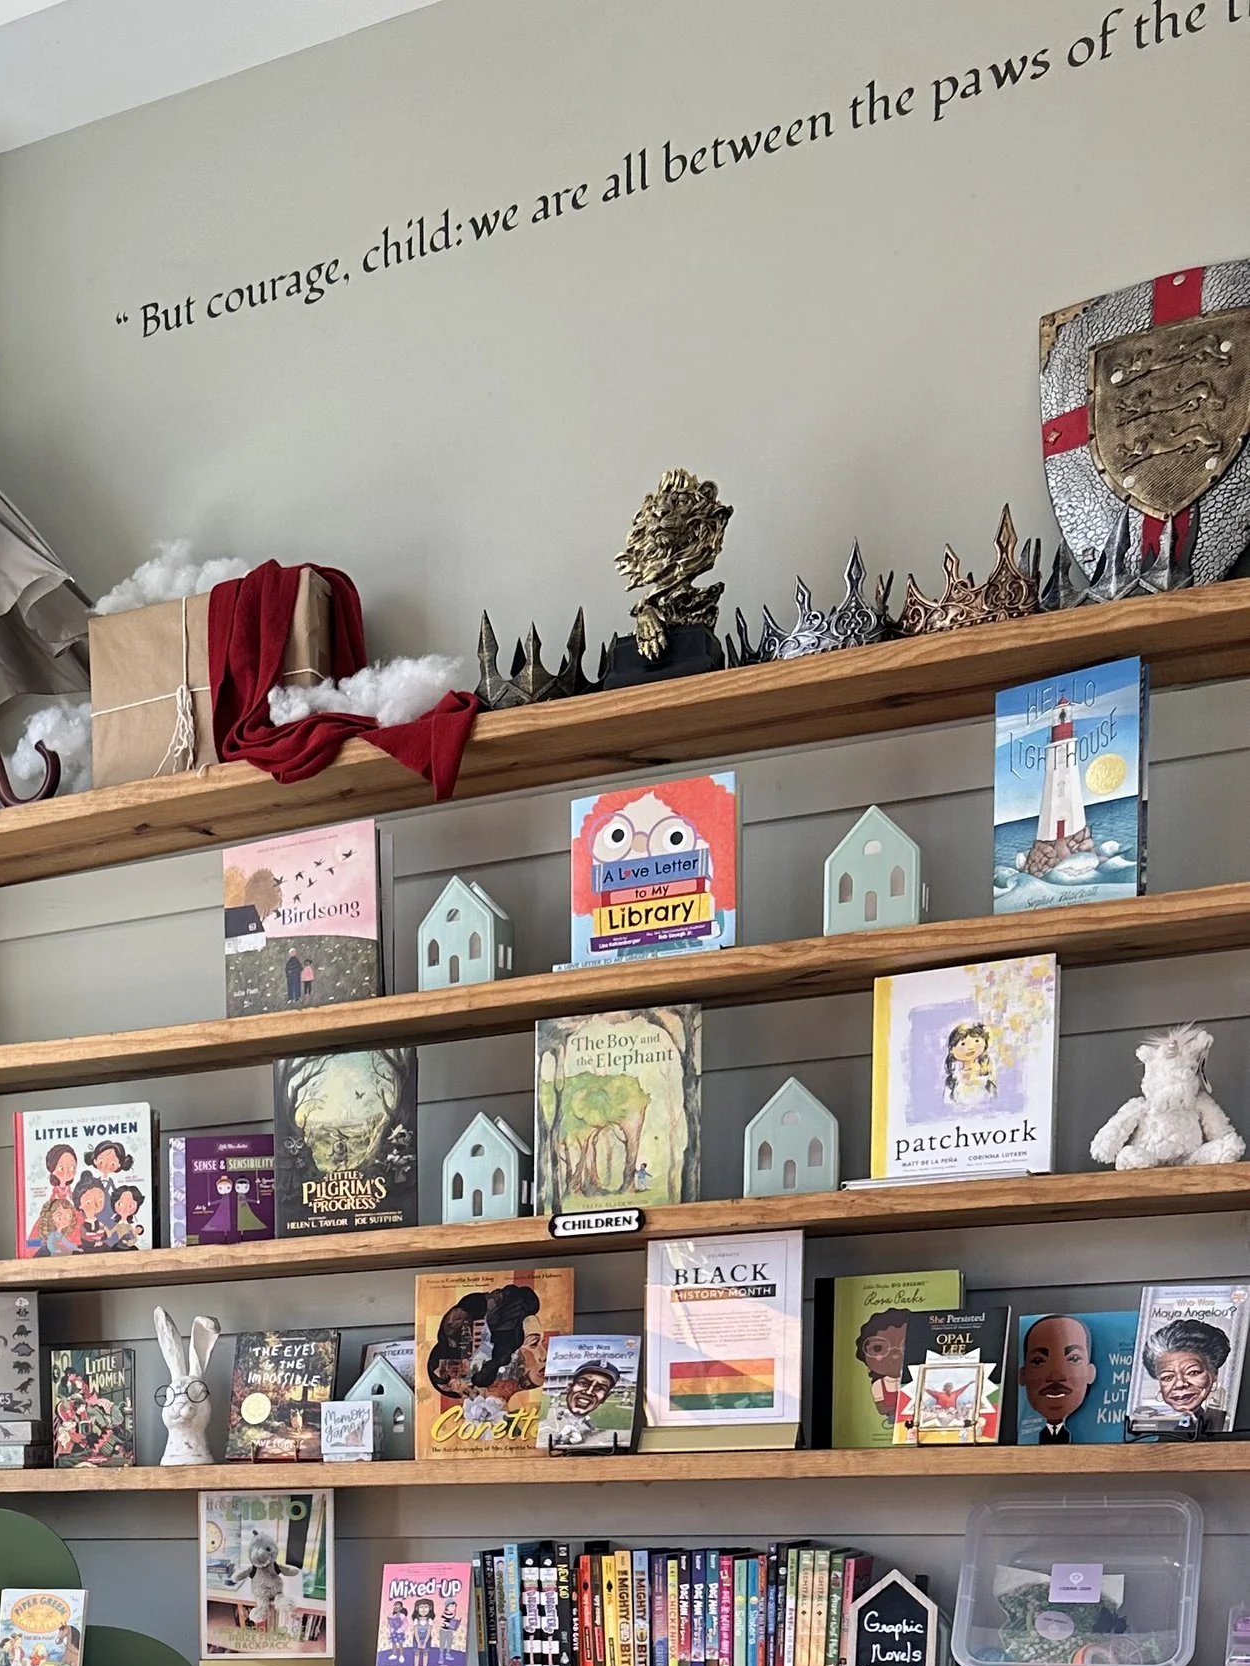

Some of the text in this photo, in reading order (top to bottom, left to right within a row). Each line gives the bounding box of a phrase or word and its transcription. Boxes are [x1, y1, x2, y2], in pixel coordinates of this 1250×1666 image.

[206, 258, 350, 305] courage,
[531, 183, 588, 223] are
[602, 149, 650, 205] all
[663, 109, 835, 183] between
[850, 80, 914, 130] the
[931, 48, 1051, 121] paws
[1068, 8, 1124, 68] of
[1134, 2, 1207, 50] the
[1027, 679, 1096, 728] HELLO
[1010, 707, 1117, 778] LIGHTHOUSE
[604, 871, 613, 883] A
[655, 859, 699, 874] Letter
[635, 885, 669, 899] to My
[282, 900, 360, 925] Birdsong
[608, 900, 695, 930] Library
[571, 1033, 660, 1054] The Boy and
[597, 1047, 674, 1071] Elephant
[35, 1122, 138, 1140] LITTLE WOMEN
[895, 1119, 1037, 1160] patchwork
[194, 1158, 274, 1171] SENSE & SENSIBILITY
[330, 1170, 358, 1180] LITTLE
[302, 1177, 386, 1204] PILGRIM'S
[313, 1197, 376, 1213] PROGRESS
[320, 1218, 348, 1227] TAYLOR
[355, 1218, 367, 1226] JOE
[562, 1216, 633, 1231] CHILDREN
[674, 1262, 770, 1286] BLACK
[673, 1286, 771, 1301] HISTORY MONTH
[864, 1288, 926, 1306] Rosa Parks
[929, 1313, 985, 1324] She Persisted
[1152, 1307, 1237, 1320] Maya Angelou?
[936, 1333, 974, 1344] OPAL
[252, 1342, 316, 1357] THE EYES
[552, 1349, 635, 1361] Jackie Robinson?
[942, 1344, 967, 1355] LEE
[85, 1356, 117, 1376] LITTLE
[280, 1359, 305, 1369] THE
[88, 1370, 125, 1393] WOMEN
[247, 1371, 321, 1387] IMPOSSIBLE
[225, 1495, 307, 1522] LIBRO
[558, 1564, 569, 1599] NEW KID
[14, 1596, 68, 1615] PIPER GREEN
[864, 1610, 924, 1641] Graphic
[871, 1641, 922, 1663] Novels
